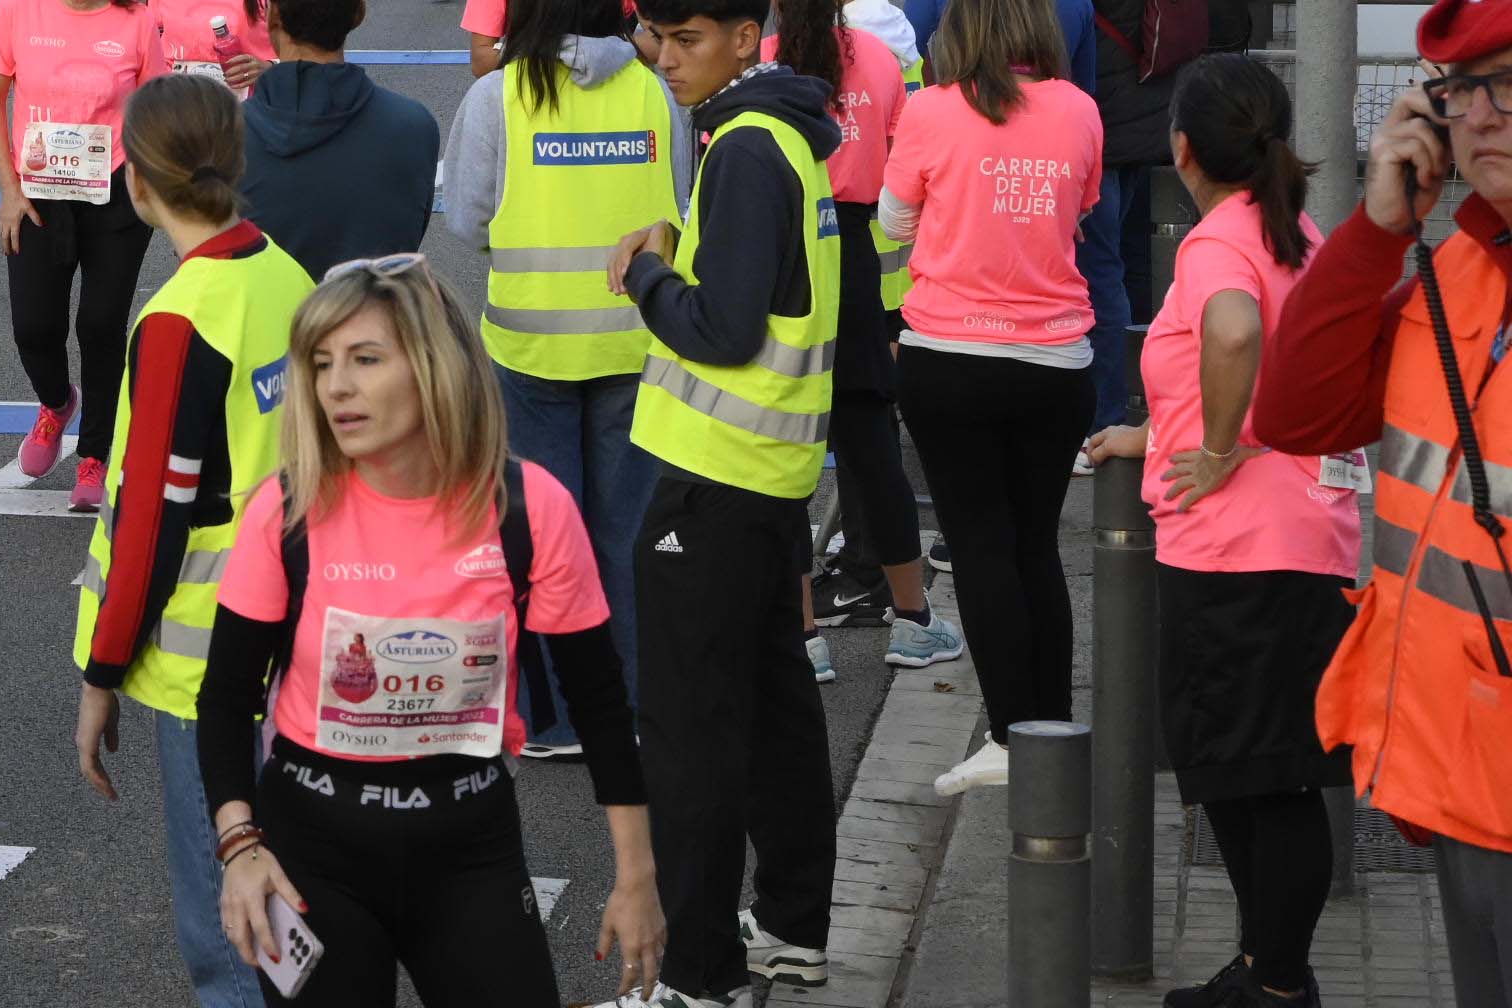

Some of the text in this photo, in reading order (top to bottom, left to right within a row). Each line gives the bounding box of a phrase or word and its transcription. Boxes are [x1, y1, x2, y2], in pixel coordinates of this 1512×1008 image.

[536, 138, 647, 159] VOLUNTARIS
[49, 155, 80, 167] 016
[979, 157, 1071, 180] CARRERA
[996, 177, 1054, 197] DE LA
[992, 196, 1056, 217] MUJER
[963, 315, 1016, 333] OYSHO
[654, 544, 683, 553] adidas
[324, 562, 396, 582] OYSHO
[381, 642, 451, 657] ASTURIANA
[383, 675, 445, 694] 016
[387, 698, 436, 712] 23677
[339, 711, 388, 724] CARRERA
[389, 715, 404, 725] DE
[406, 714, 421, 725] LA
[332, 729, 387, 746] OYSHO
[432, 732, 488, 744] Santander
[453, 764, 500, 801] FILA
[360, 784, 432, 810] FILA
